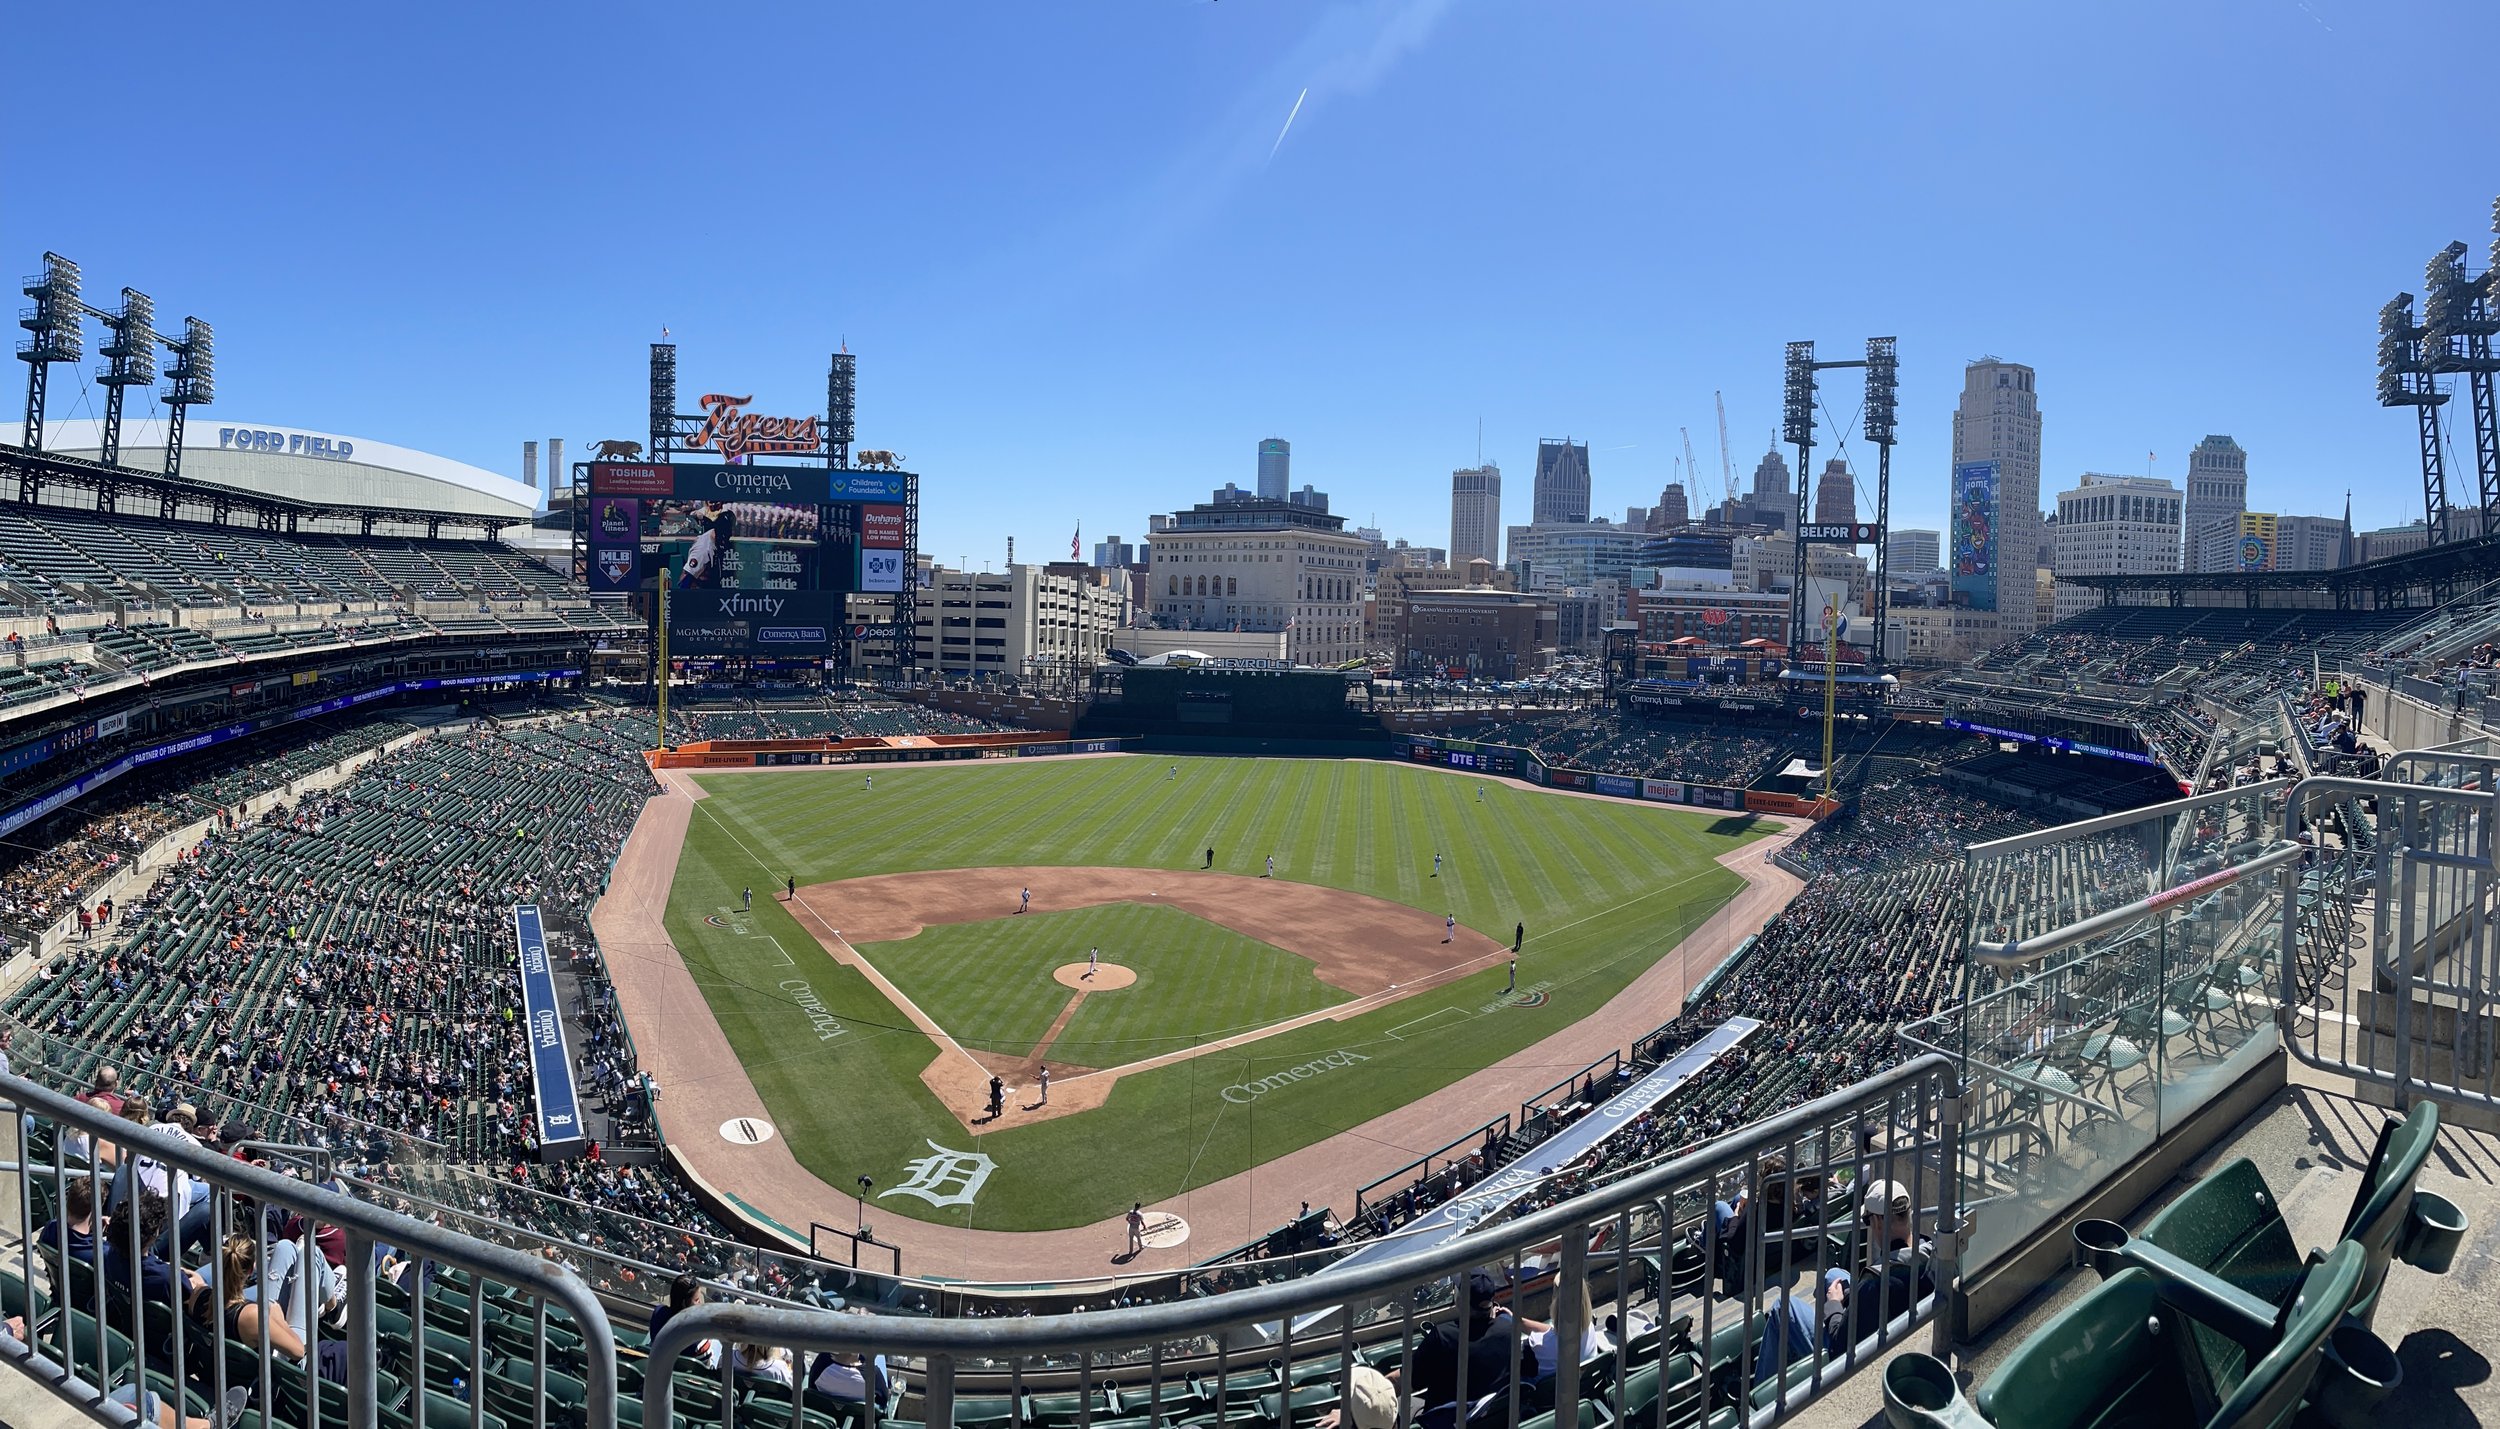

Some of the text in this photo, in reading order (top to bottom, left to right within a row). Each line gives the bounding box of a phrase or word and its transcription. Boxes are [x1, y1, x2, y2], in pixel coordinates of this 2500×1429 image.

[684, 394, 821, 463] Tigers
[219, 428, 354, 460] FORD FIELD
[610, 468, 656, 478] TOSHIBA
[852, 479, 883, 487] Children's
[1964, 480, 1989, 494] HOME
[866, 514, 902, 523] Dunham's
[1800, 526, 1849, 538] BELFOR
[601, 552, 630, 560] MLB
[719, 593, 784, 617] xfinity
[1702, 609, 1726, 624] AAA
[676, 628, 746, 636] MGM GRAND
[801, 629, 820, 640] Bank
[869, 627, 895, 638] pepsi
[1204, 657, 1295, 670] CHEVROLET
[1710, 656, 1726, 666] Lite
[1803, 664, 1848, 672] COPPERCAFT
[1664, 697, 1682, 705] Bank
[1719, 701, 1739, 712] Bally
[102, 721, 117, 732] BELFOR
[135, 751, 158, 763] PARTNER
[160, 748, 167, 756] OF
[167, 745, 176, 754] THE
[177, 740, 196, 752] DETROIT
[196, 735, 212, 745] TIGERS
[1088, 743, 1105, 751] DTE
[2074, 744, 2089, 752] PROUD
[2090, 746, 2108, 755] PARTNER
[2116, 750, 2124, 758] THE
[2125, 752, 2144, 761] DETROIT
[791, 755, 806, 763] Lite
[1451, 753, 1473, 766] DTE
[1552, 774, 1586, 785] POINTSBET
[1607, 778, 1634, 788] McLaren
[1647, 783, 1680, 798] meijer
[25, 808, 32, 819] OF
[33, 803, 42, 813] THE
[43, 794, 62, 810] DETROIT
[62, 784, 78, 799] TIGERS
[1704, 792, 1722, 802] Modelo
[533, 1020, 541, 1038] PARK
[1632, 1089, 1662, 1110] PARK
